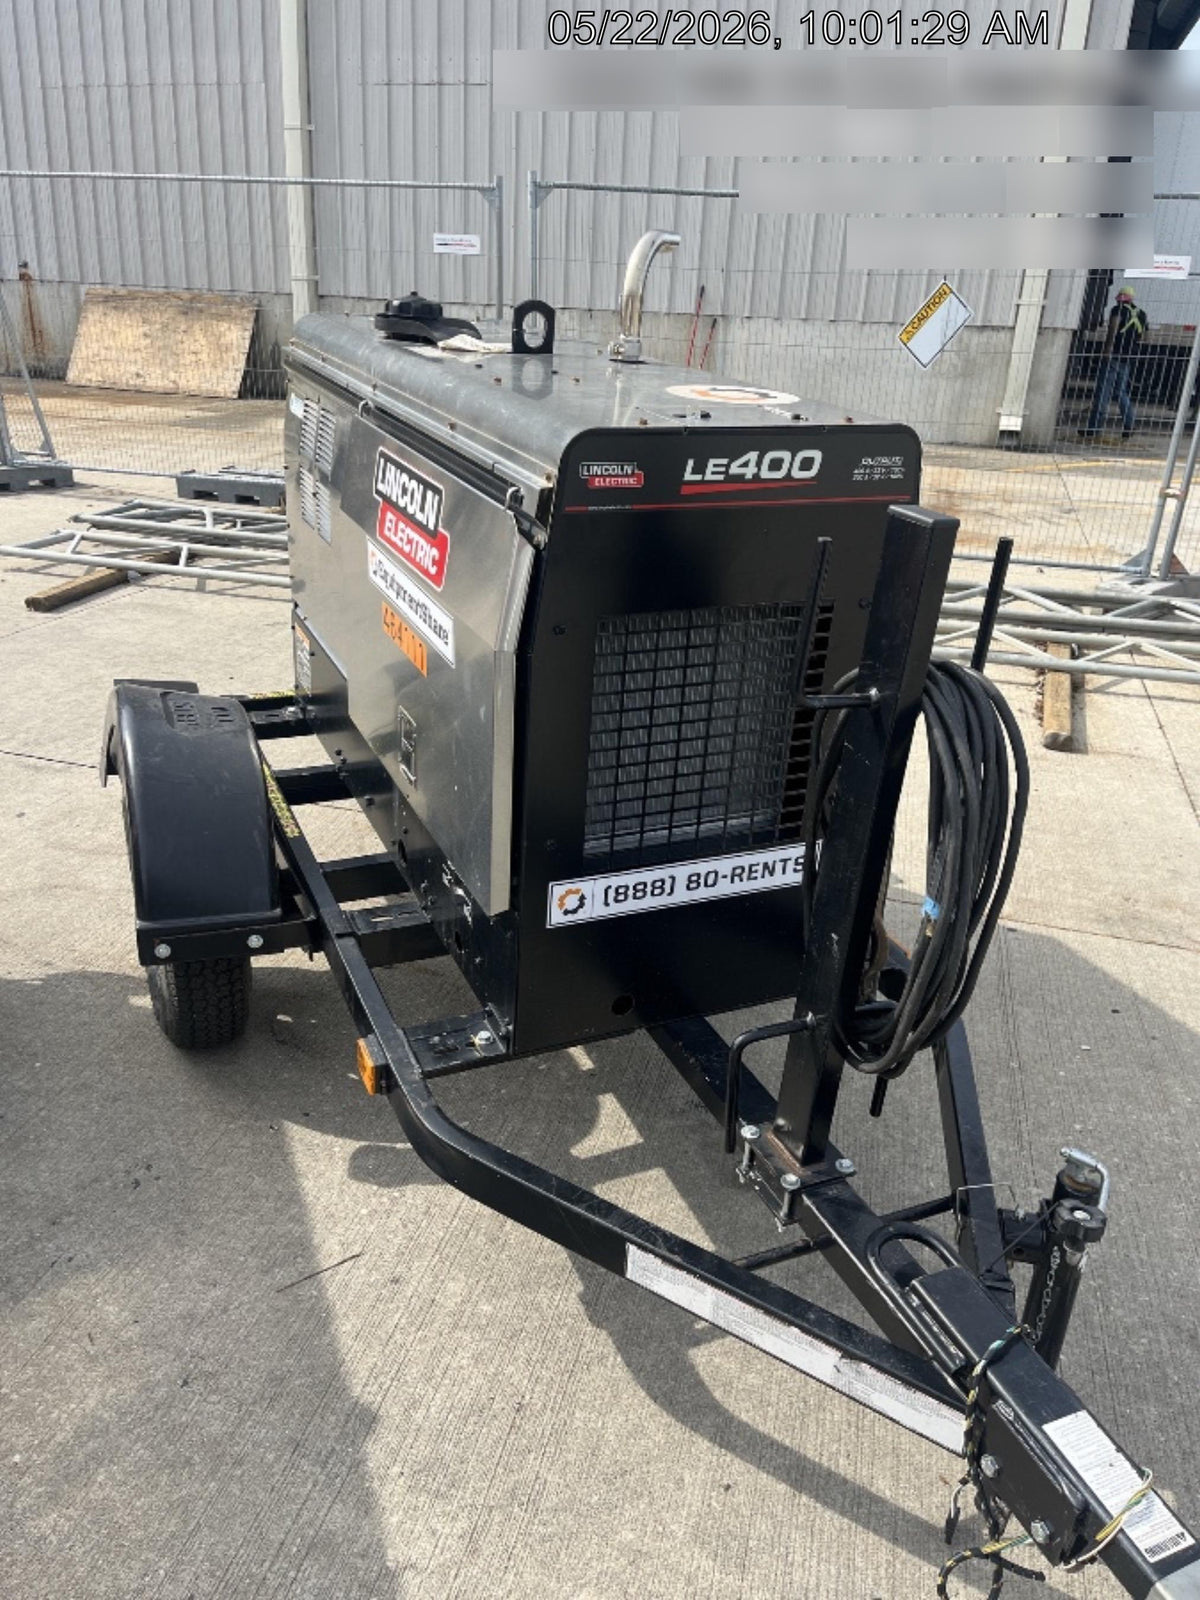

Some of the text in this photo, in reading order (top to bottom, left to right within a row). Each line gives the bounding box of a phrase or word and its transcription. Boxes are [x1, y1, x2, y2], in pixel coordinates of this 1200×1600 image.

[911, 288, 947, 330] CAUTION
[581, 463, 634, 476] LINCOLN
[594, 477, 638, 486] ELECTRIC
[682, 449, 823, 481] LE400
[376, 457, 440, 531] LINCOLN
[383, 511, 440, 576] ELECTRIC
[603, 854, 805, 907] (888) 80-RENTS
